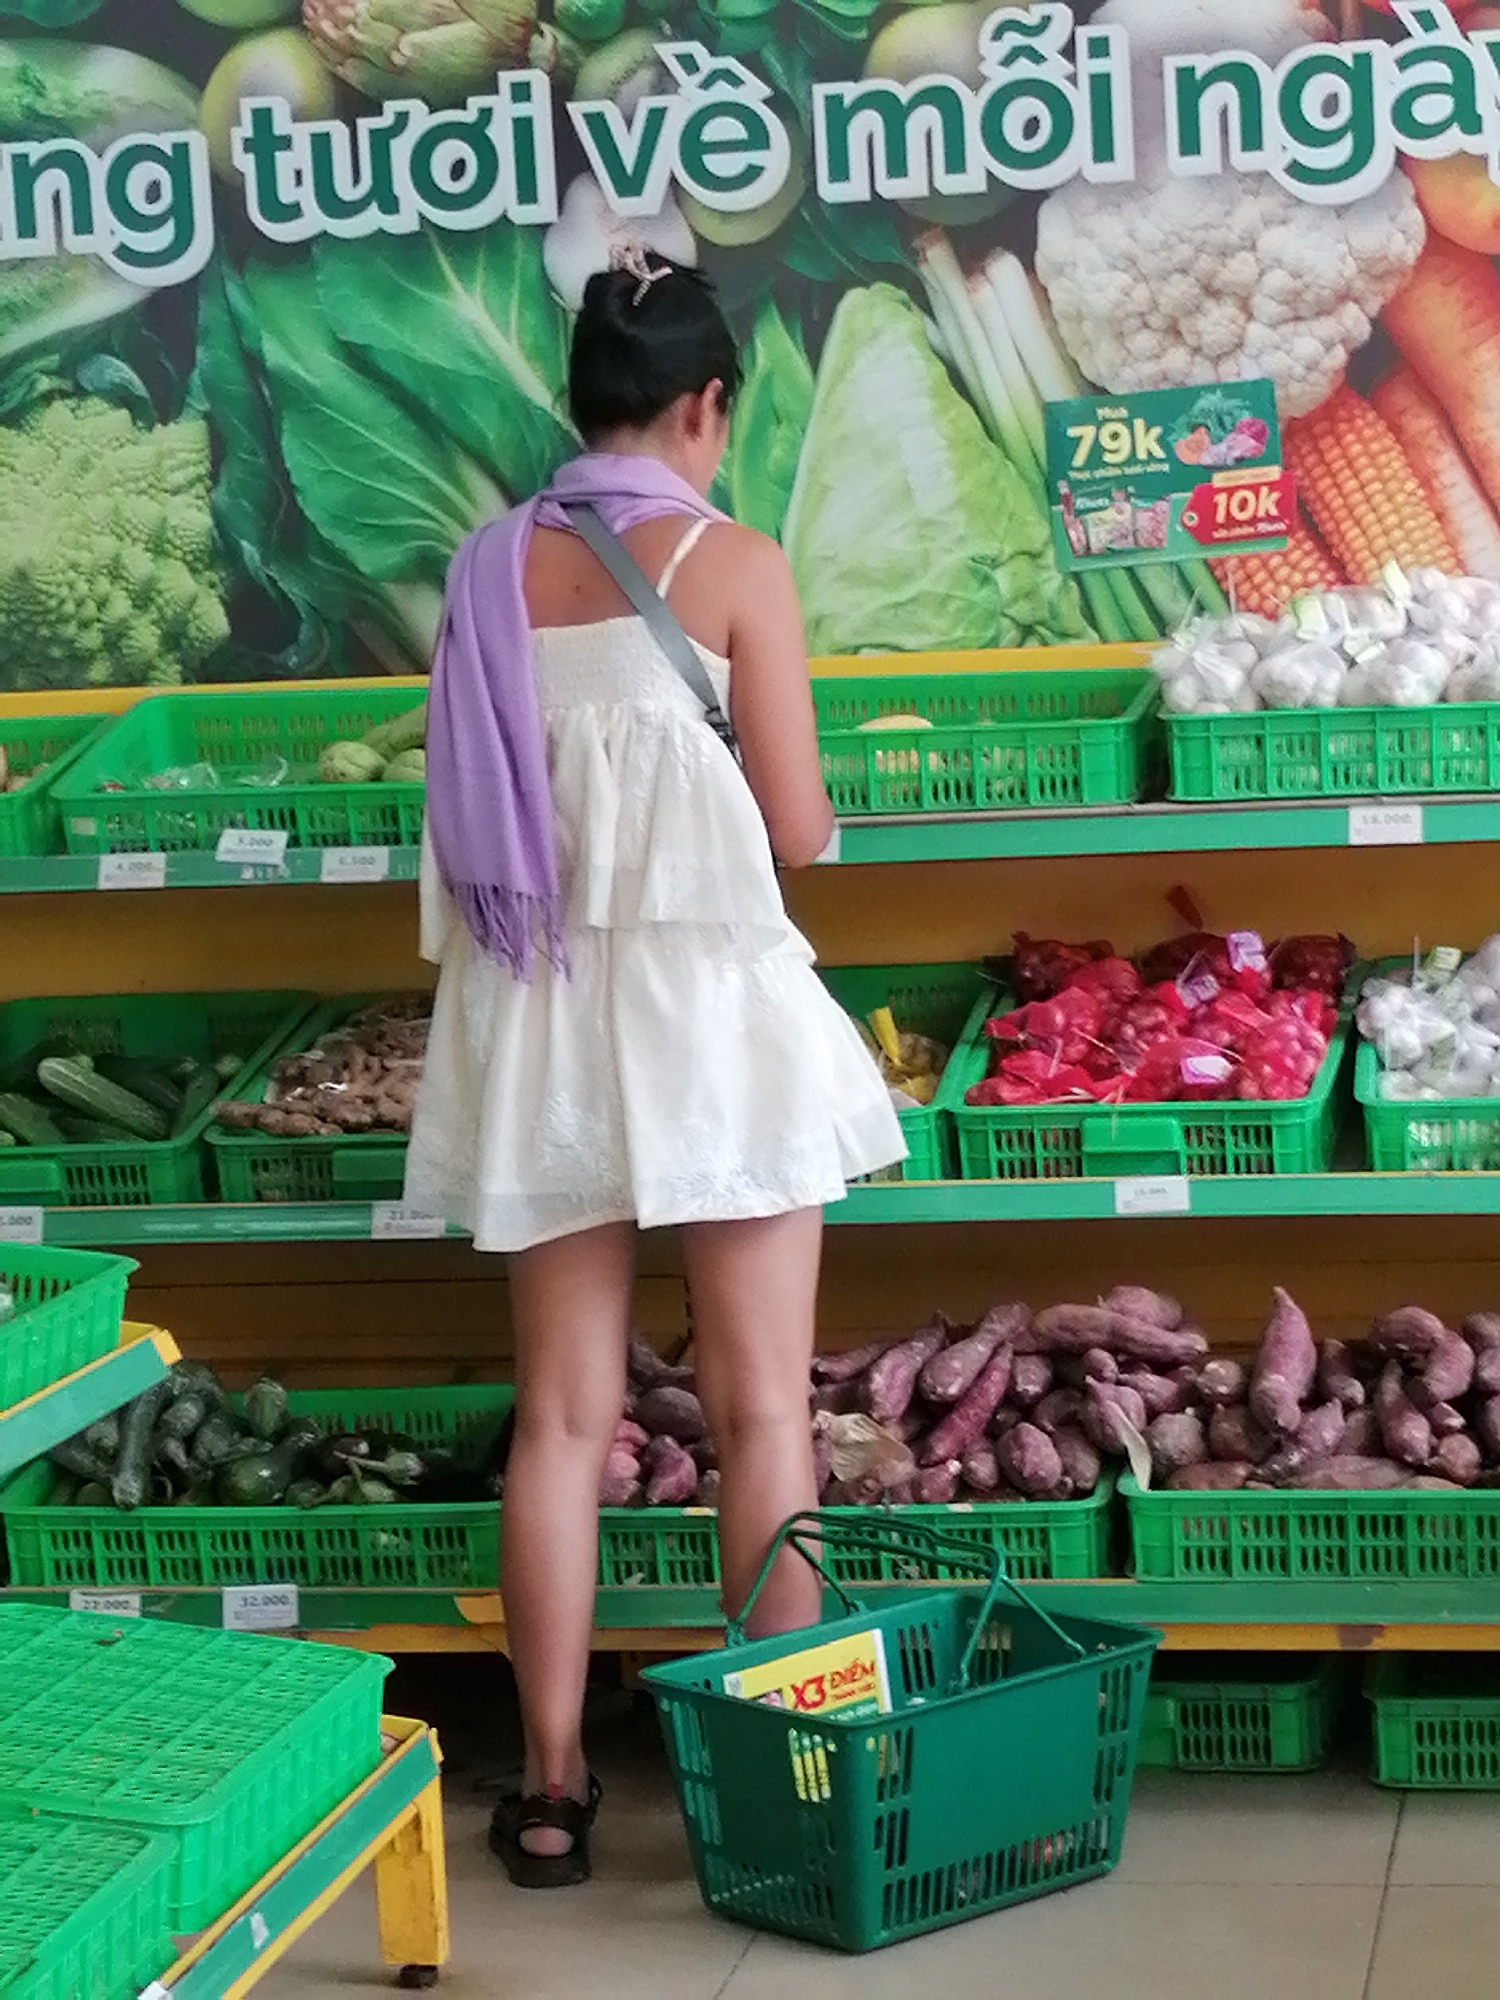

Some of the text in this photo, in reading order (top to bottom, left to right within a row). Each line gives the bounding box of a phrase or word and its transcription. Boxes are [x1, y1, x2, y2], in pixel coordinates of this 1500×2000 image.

[4, 139, 196, 269] ng
[242, 80, 543, 224] tươi
[579, 51, 771, 199] về
[822, 13, 1116, 185] mỗi
[1065, 417, 1167, 468] 79k
[1212, 486, 1283, 524] 10k
[790, 1673, 827, 1710] X3
